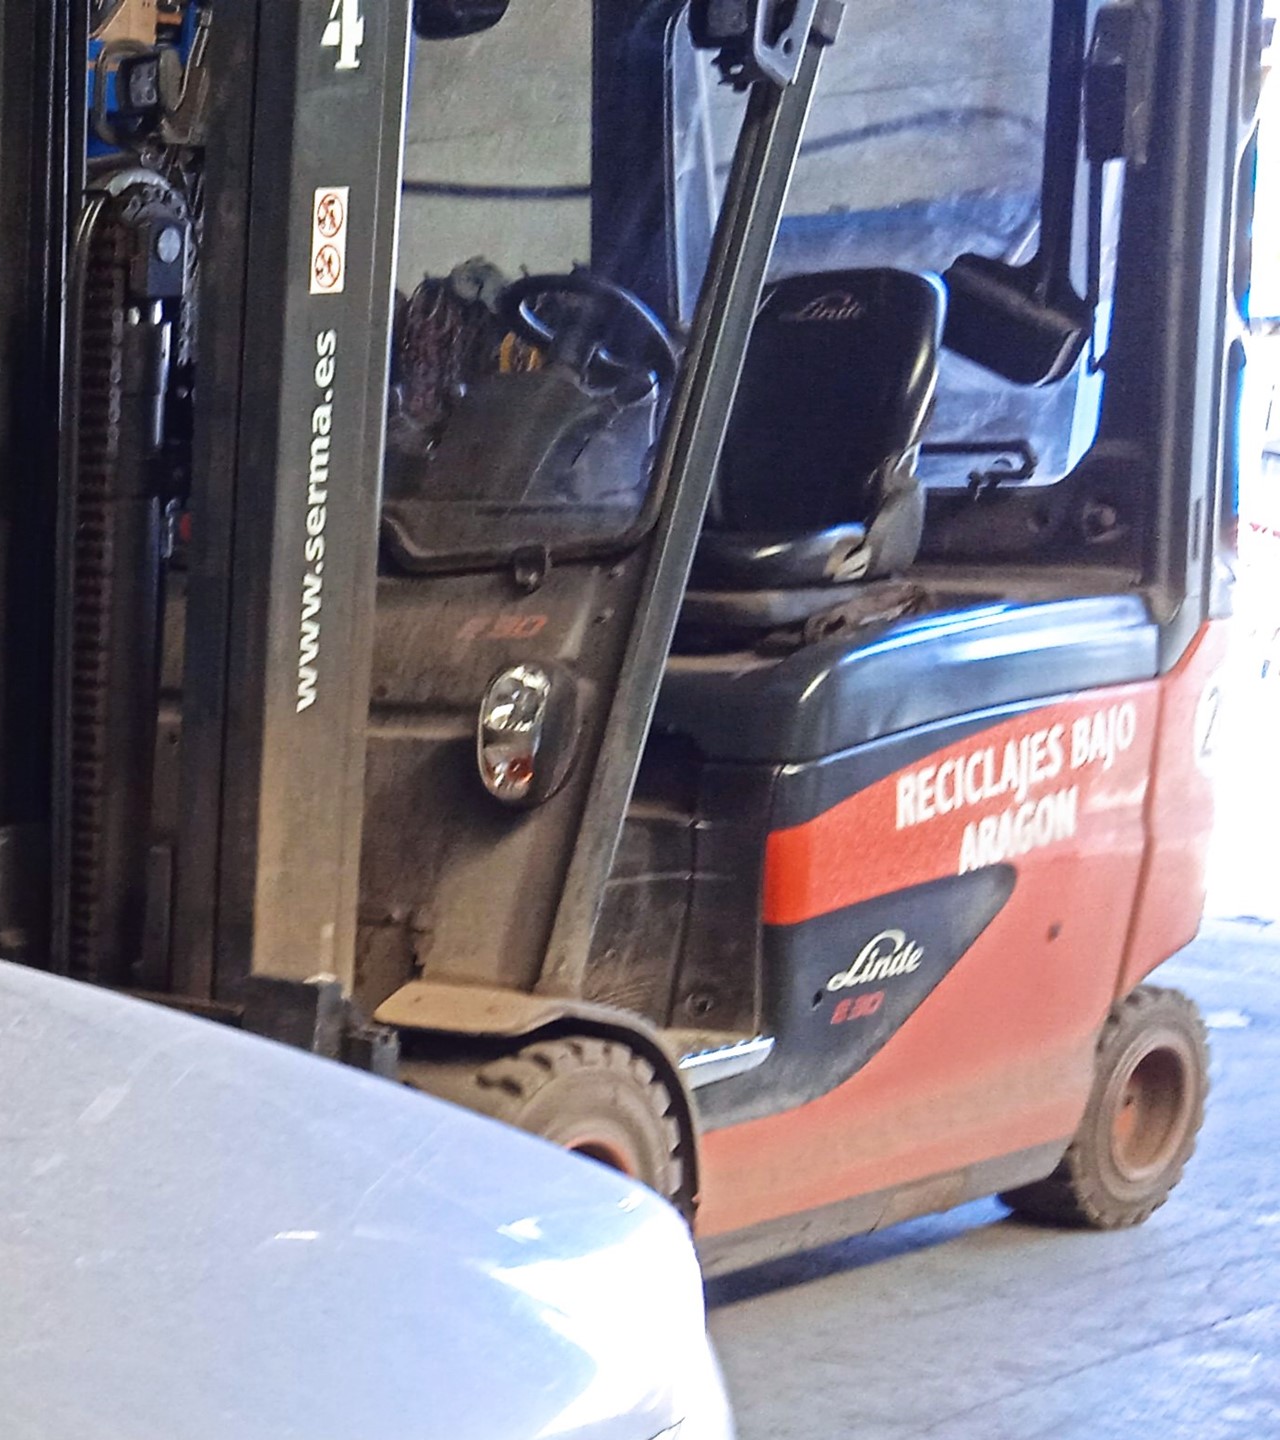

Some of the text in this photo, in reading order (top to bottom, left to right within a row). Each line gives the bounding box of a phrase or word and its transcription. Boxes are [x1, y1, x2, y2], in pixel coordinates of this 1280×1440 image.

[320, 0, 364, 71] 4
[296, 328, 337, 714] www.serma.es
[895, 701, 1137, 832] RECICLAJES BAJO
[958, 784, 1080, 876] ARAGON
[826, 928, 924, 992] Linde
